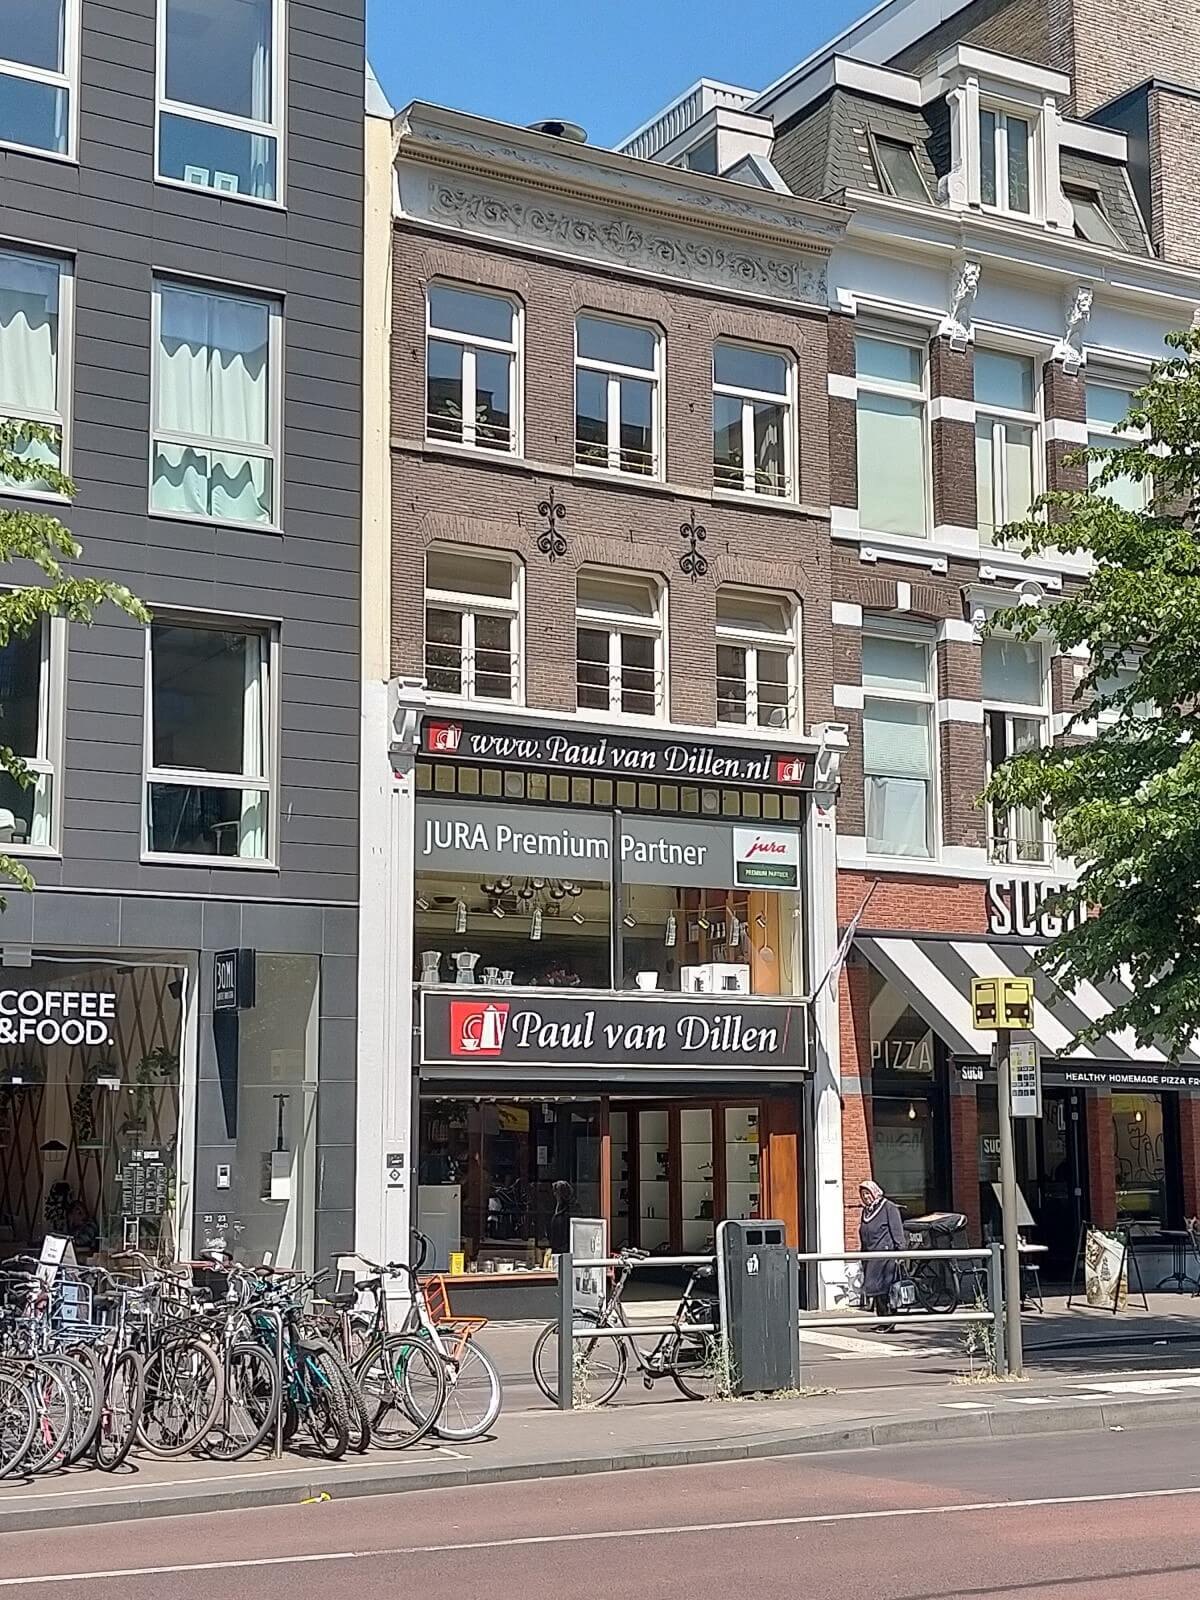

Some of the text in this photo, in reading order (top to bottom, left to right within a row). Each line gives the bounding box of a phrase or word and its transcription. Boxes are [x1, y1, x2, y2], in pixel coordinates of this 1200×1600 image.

[611, 748, 656, 769] van
[664, 745, 771, 780] Dillen.nl
[422, 820, 707, 865] JURA Premium Partner
[745, 836, 786, 858] jura
[0, 990, 115, 1017] COFFEE
[0, 1017, 114, 1045] &FOOD.
[512, 1011, 778, 1051] Paul van Dillen
[871, 1040, 932, 1070] PIZZA
[1065, 1072, 1106, 1082] HEALTHY
[1109, 1074, 1159, 1084] HOMEMADE
[1161, 1076, 1186, 1085] PIZZA
